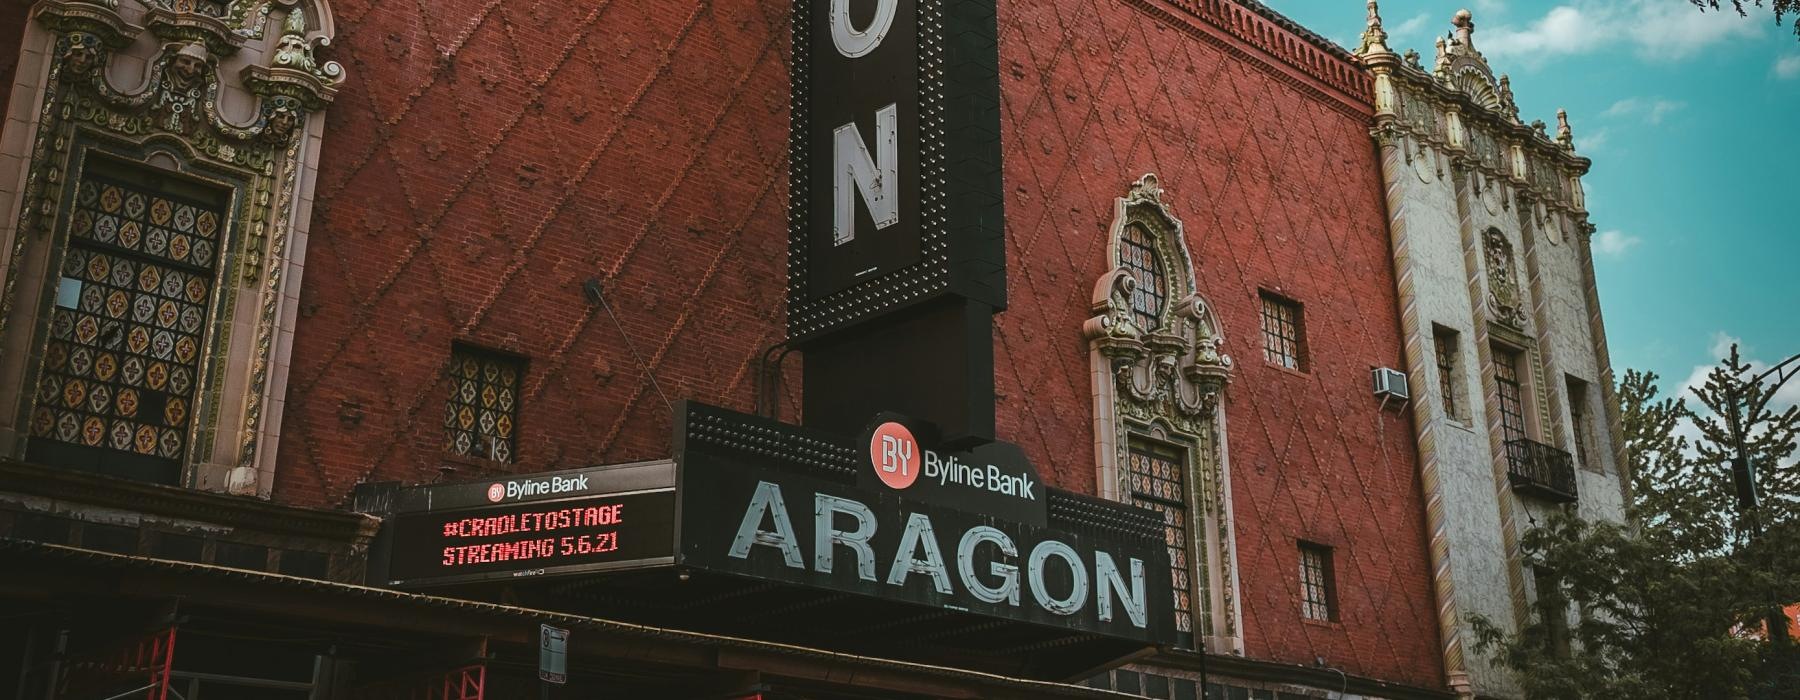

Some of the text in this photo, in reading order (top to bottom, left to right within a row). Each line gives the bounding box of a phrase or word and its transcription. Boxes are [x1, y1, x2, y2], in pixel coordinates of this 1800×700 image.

[882, 434, 1035, 500] BY Byline Bank
[491, 474, 588, 500] BY Byline Bank
[443, 504, 623, 537] #CRADLETOSTAGE
[442, 531, 618, 565] STREAMING 5.6.21
[728, 480, 1148, 629] ARAGON
